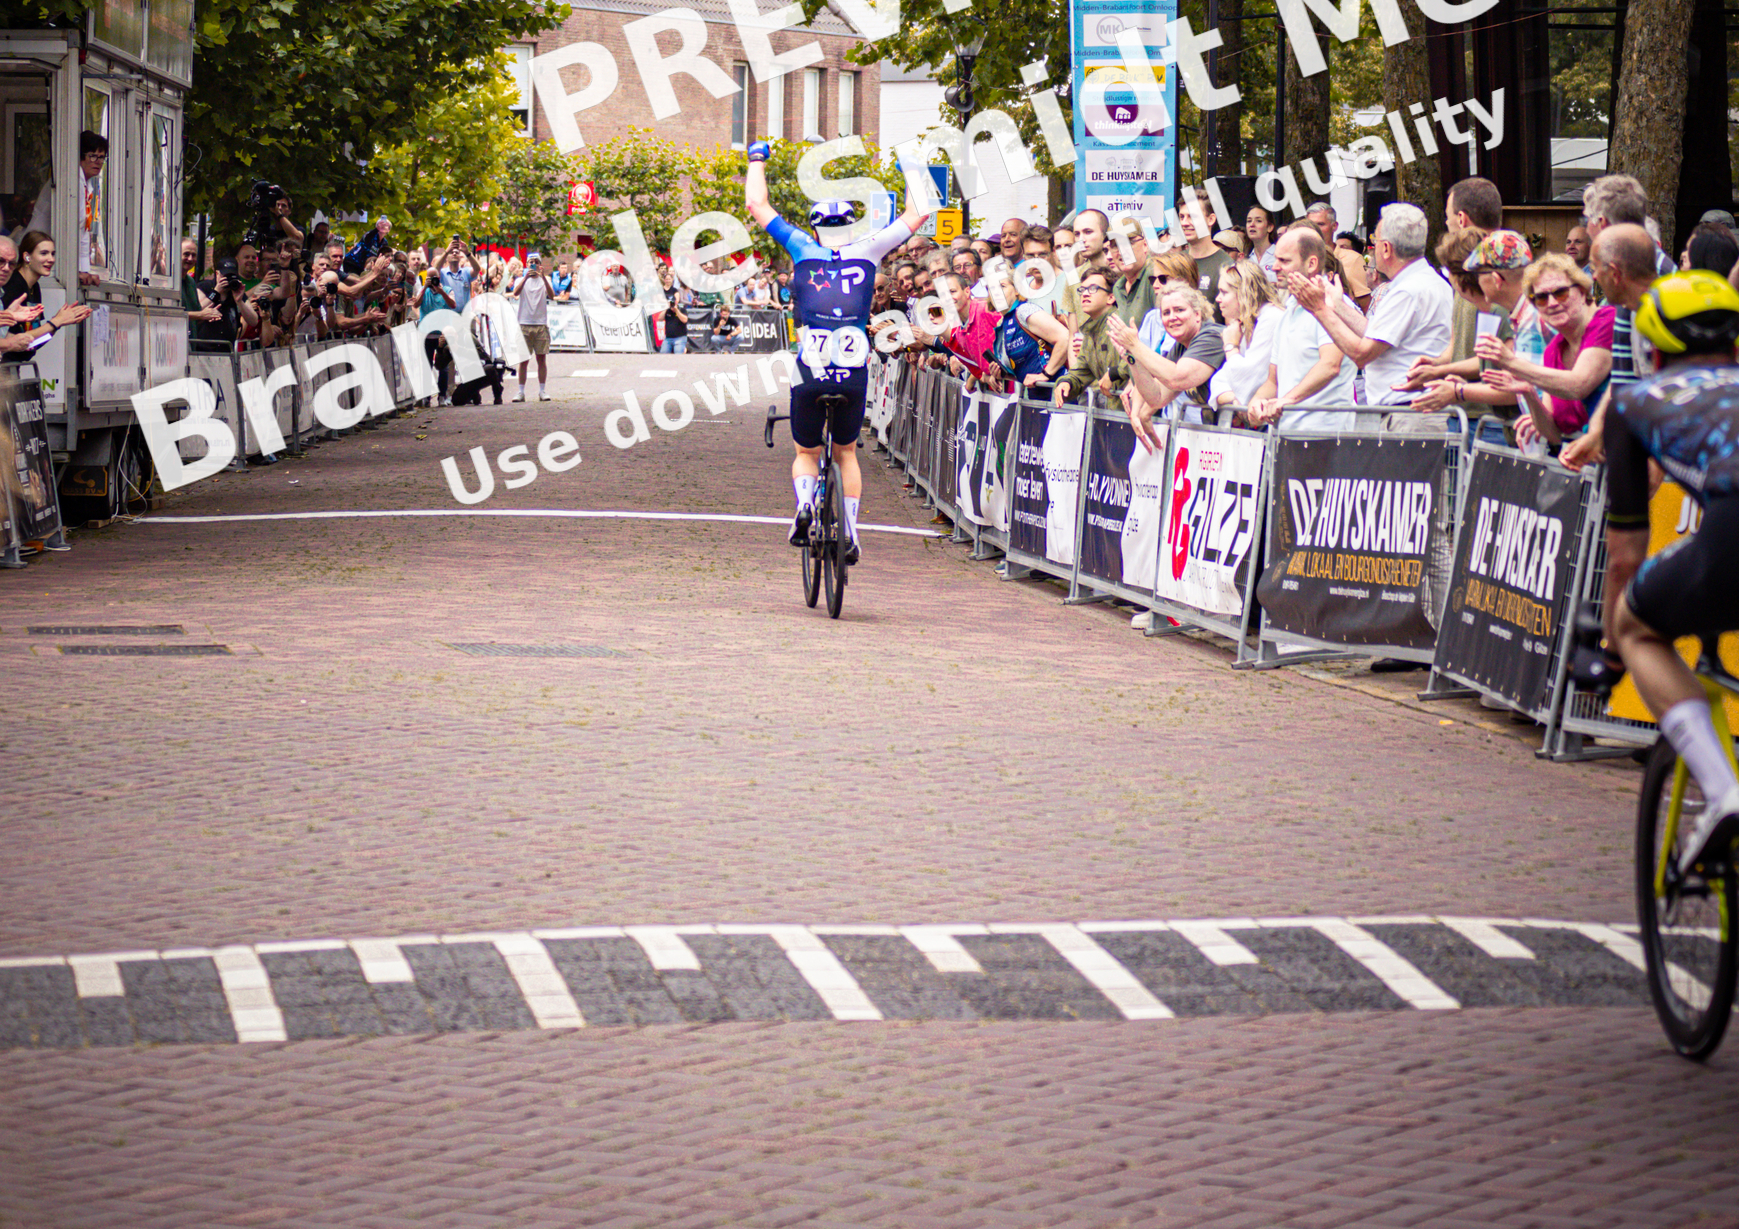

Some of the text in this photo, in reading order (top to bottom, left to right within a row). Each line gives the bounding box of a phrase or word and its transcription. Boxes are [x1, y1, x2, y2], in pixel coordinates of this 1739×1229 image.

[1100, 24, 1121, 35] MK
[1092, 172, 1158, 181] DE HUYSKAMER
[942, 219, 954, 236] 5
[752, 322, 778, 339] IDEA
[807, 334, 828, 353] 27
[1187, 476, 1253, 568] GILZE
[1288, 478, 1433, 555] DE HUYSKAMER
[1469, 496, 1500, 576] DE
